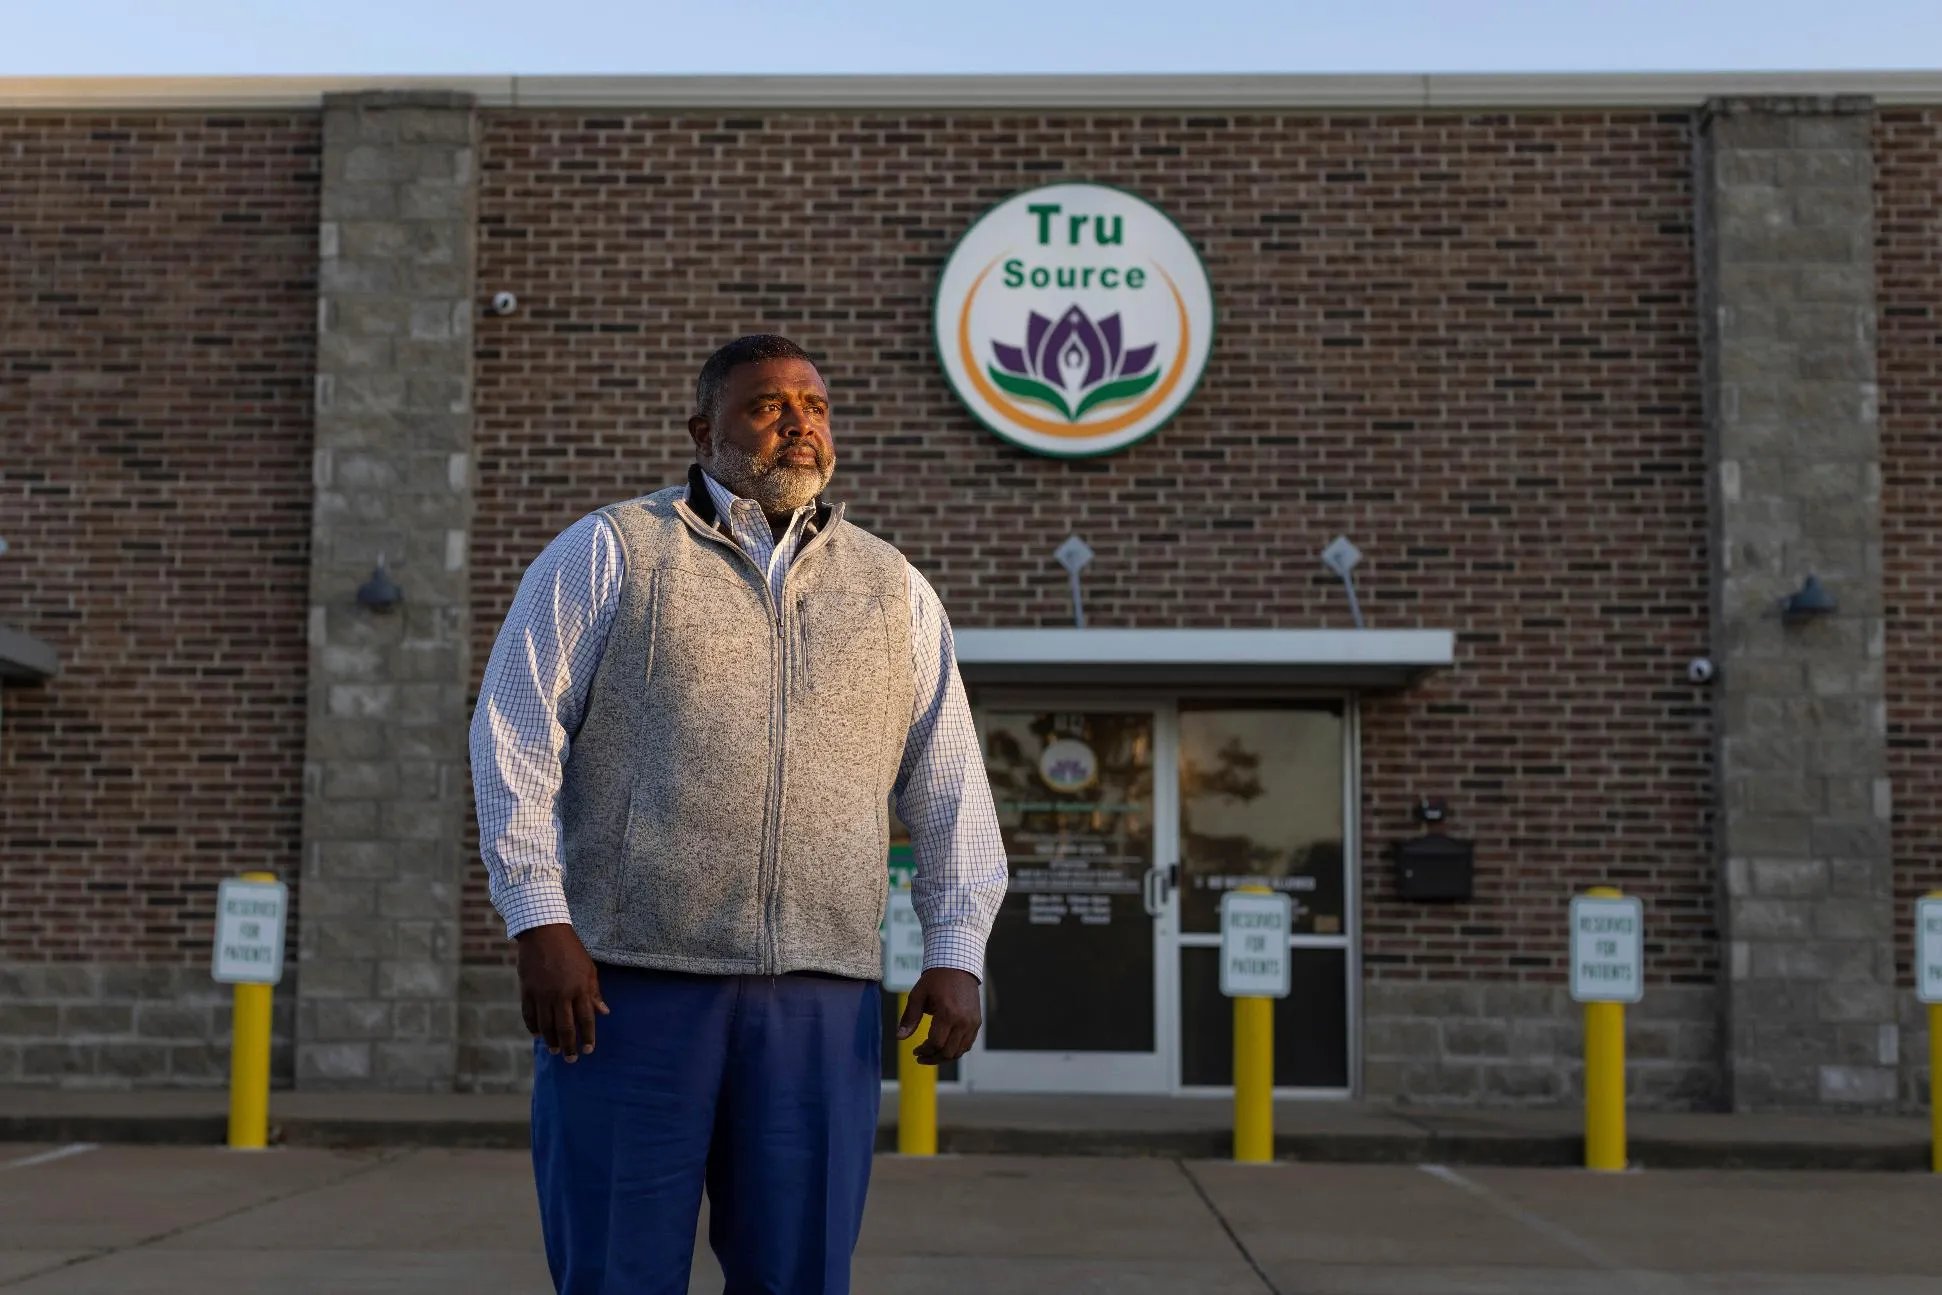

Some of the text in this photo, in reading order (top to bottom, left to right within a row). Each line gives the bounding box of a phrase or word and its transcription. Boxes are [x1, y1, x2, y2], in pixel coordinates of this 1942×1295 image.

[1027, 203, 1124, 246] Tru
[1003, 259, 1147, 289] Source
[1232, 911, 1283, 930] RESERVED
[1580, 917, 1633, 934] RESERVED
[1245, 935, 1266, 952] FOR
[1595, 939, 1617, 958] FOR
[1232, 958, 1280, 976] PATIENTS
[1581, 962, 1632, 981] PATIENTS
